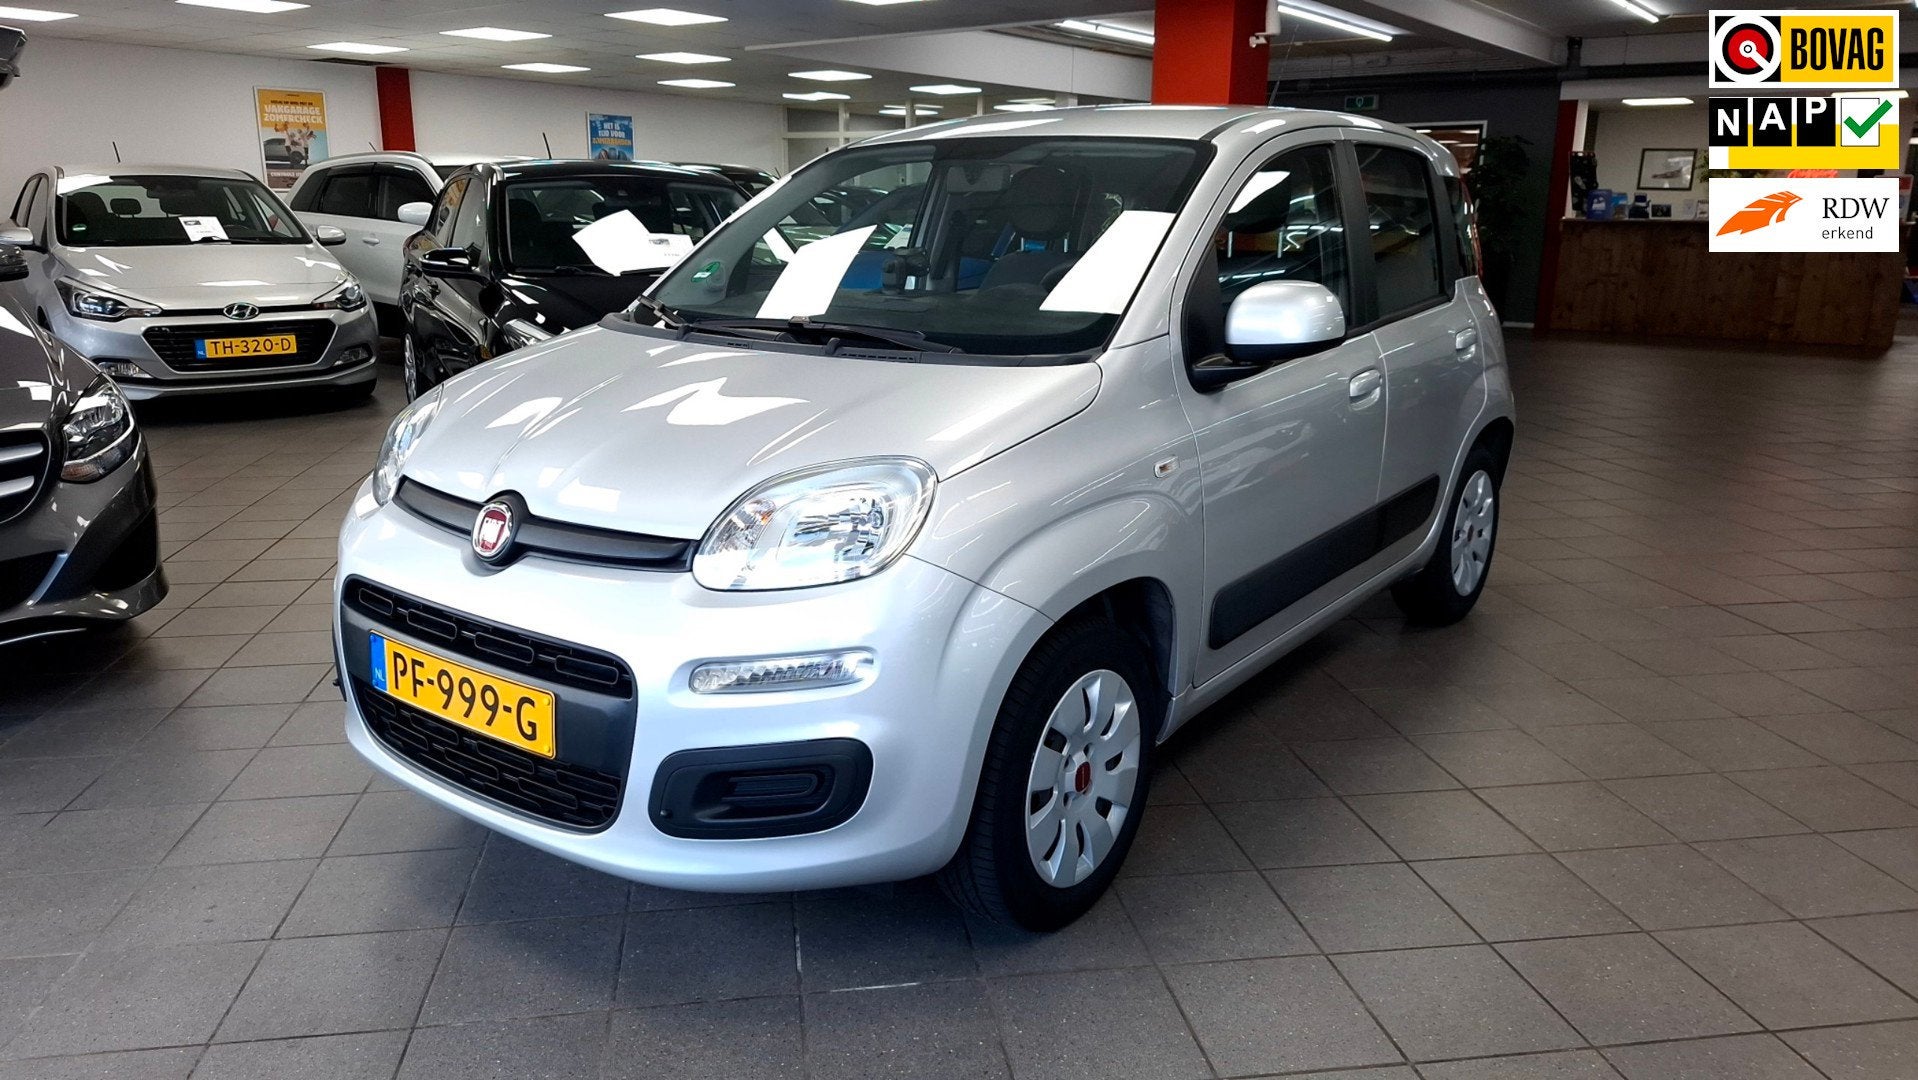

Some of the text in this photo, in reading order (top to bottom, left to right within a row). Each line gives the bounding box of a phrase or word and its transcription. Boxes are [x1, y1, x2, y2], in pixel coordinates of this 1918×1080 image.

[264, 104, 320, 115] VAKGARAGE
[264, 113, 324, 124] ZOMERCHECK
[210, 338, 291, 355] TH-320-D
[375, 650, 538, 742] NL PF-999-G
